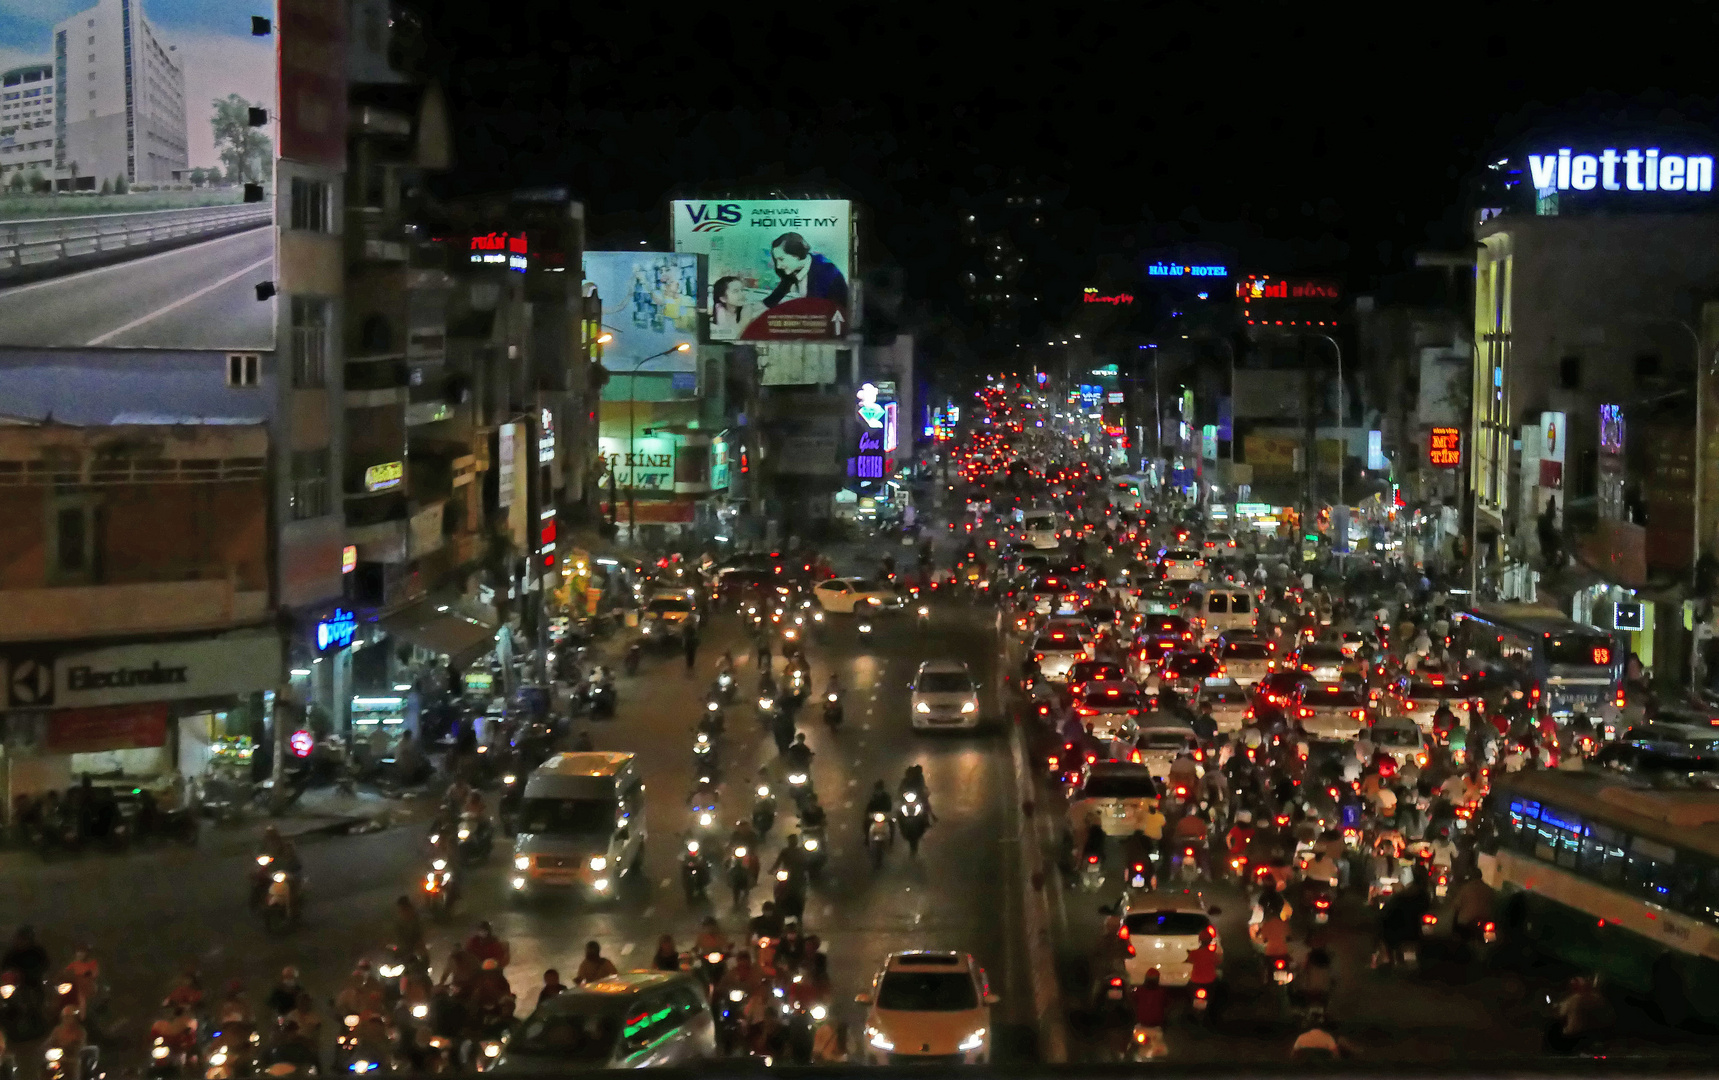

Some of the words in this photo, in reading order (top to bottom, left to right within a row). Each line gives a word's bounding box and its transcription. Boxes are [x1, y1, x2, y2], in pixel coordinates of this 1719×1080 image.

[1528, 148, 1713, 192] viettien
[685, 203, 742, 225] VUS
[779, 215, 812, 230] VIỆT
[1190, 266, 1228, 276] HOTEL
[625, 448, 672, 468] KÍNH
